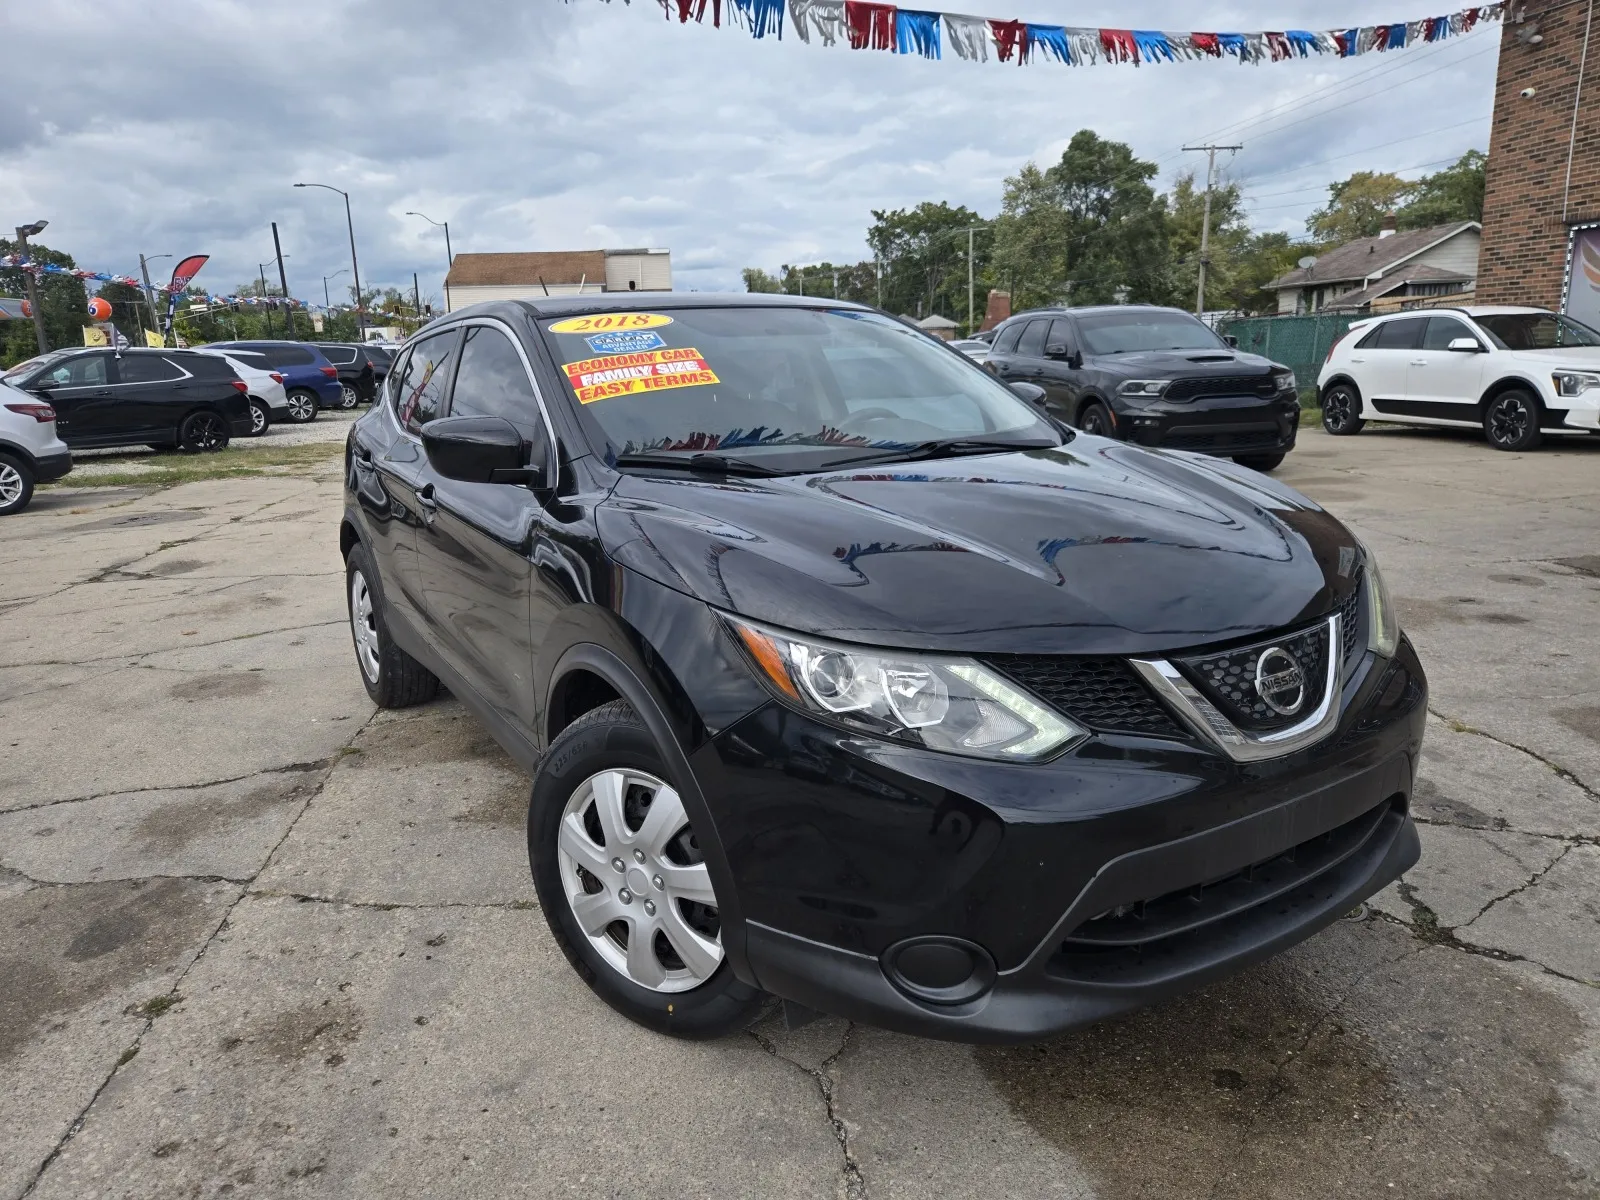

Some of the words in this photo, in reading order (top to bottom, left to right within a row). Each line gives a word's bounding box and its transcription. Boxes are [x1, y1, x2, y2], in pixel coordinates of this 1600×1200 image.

[573, 314, 651, 331] 2018
[602, 340, 654, 349] ADVANTAGE
[613, 344, 649, 352] DEALER
[567, 352, 658, 375] ECONOMY
[661, 349, 698, 360] CAR
[580, 365, 653, 387] FAMILY
[656, 361, 701, 375] SIZE
[579, 380, 635, 401] EASY
[640, 372, 713, 389] TERMS
[1261, 672, 1300, 691] NISSAN
